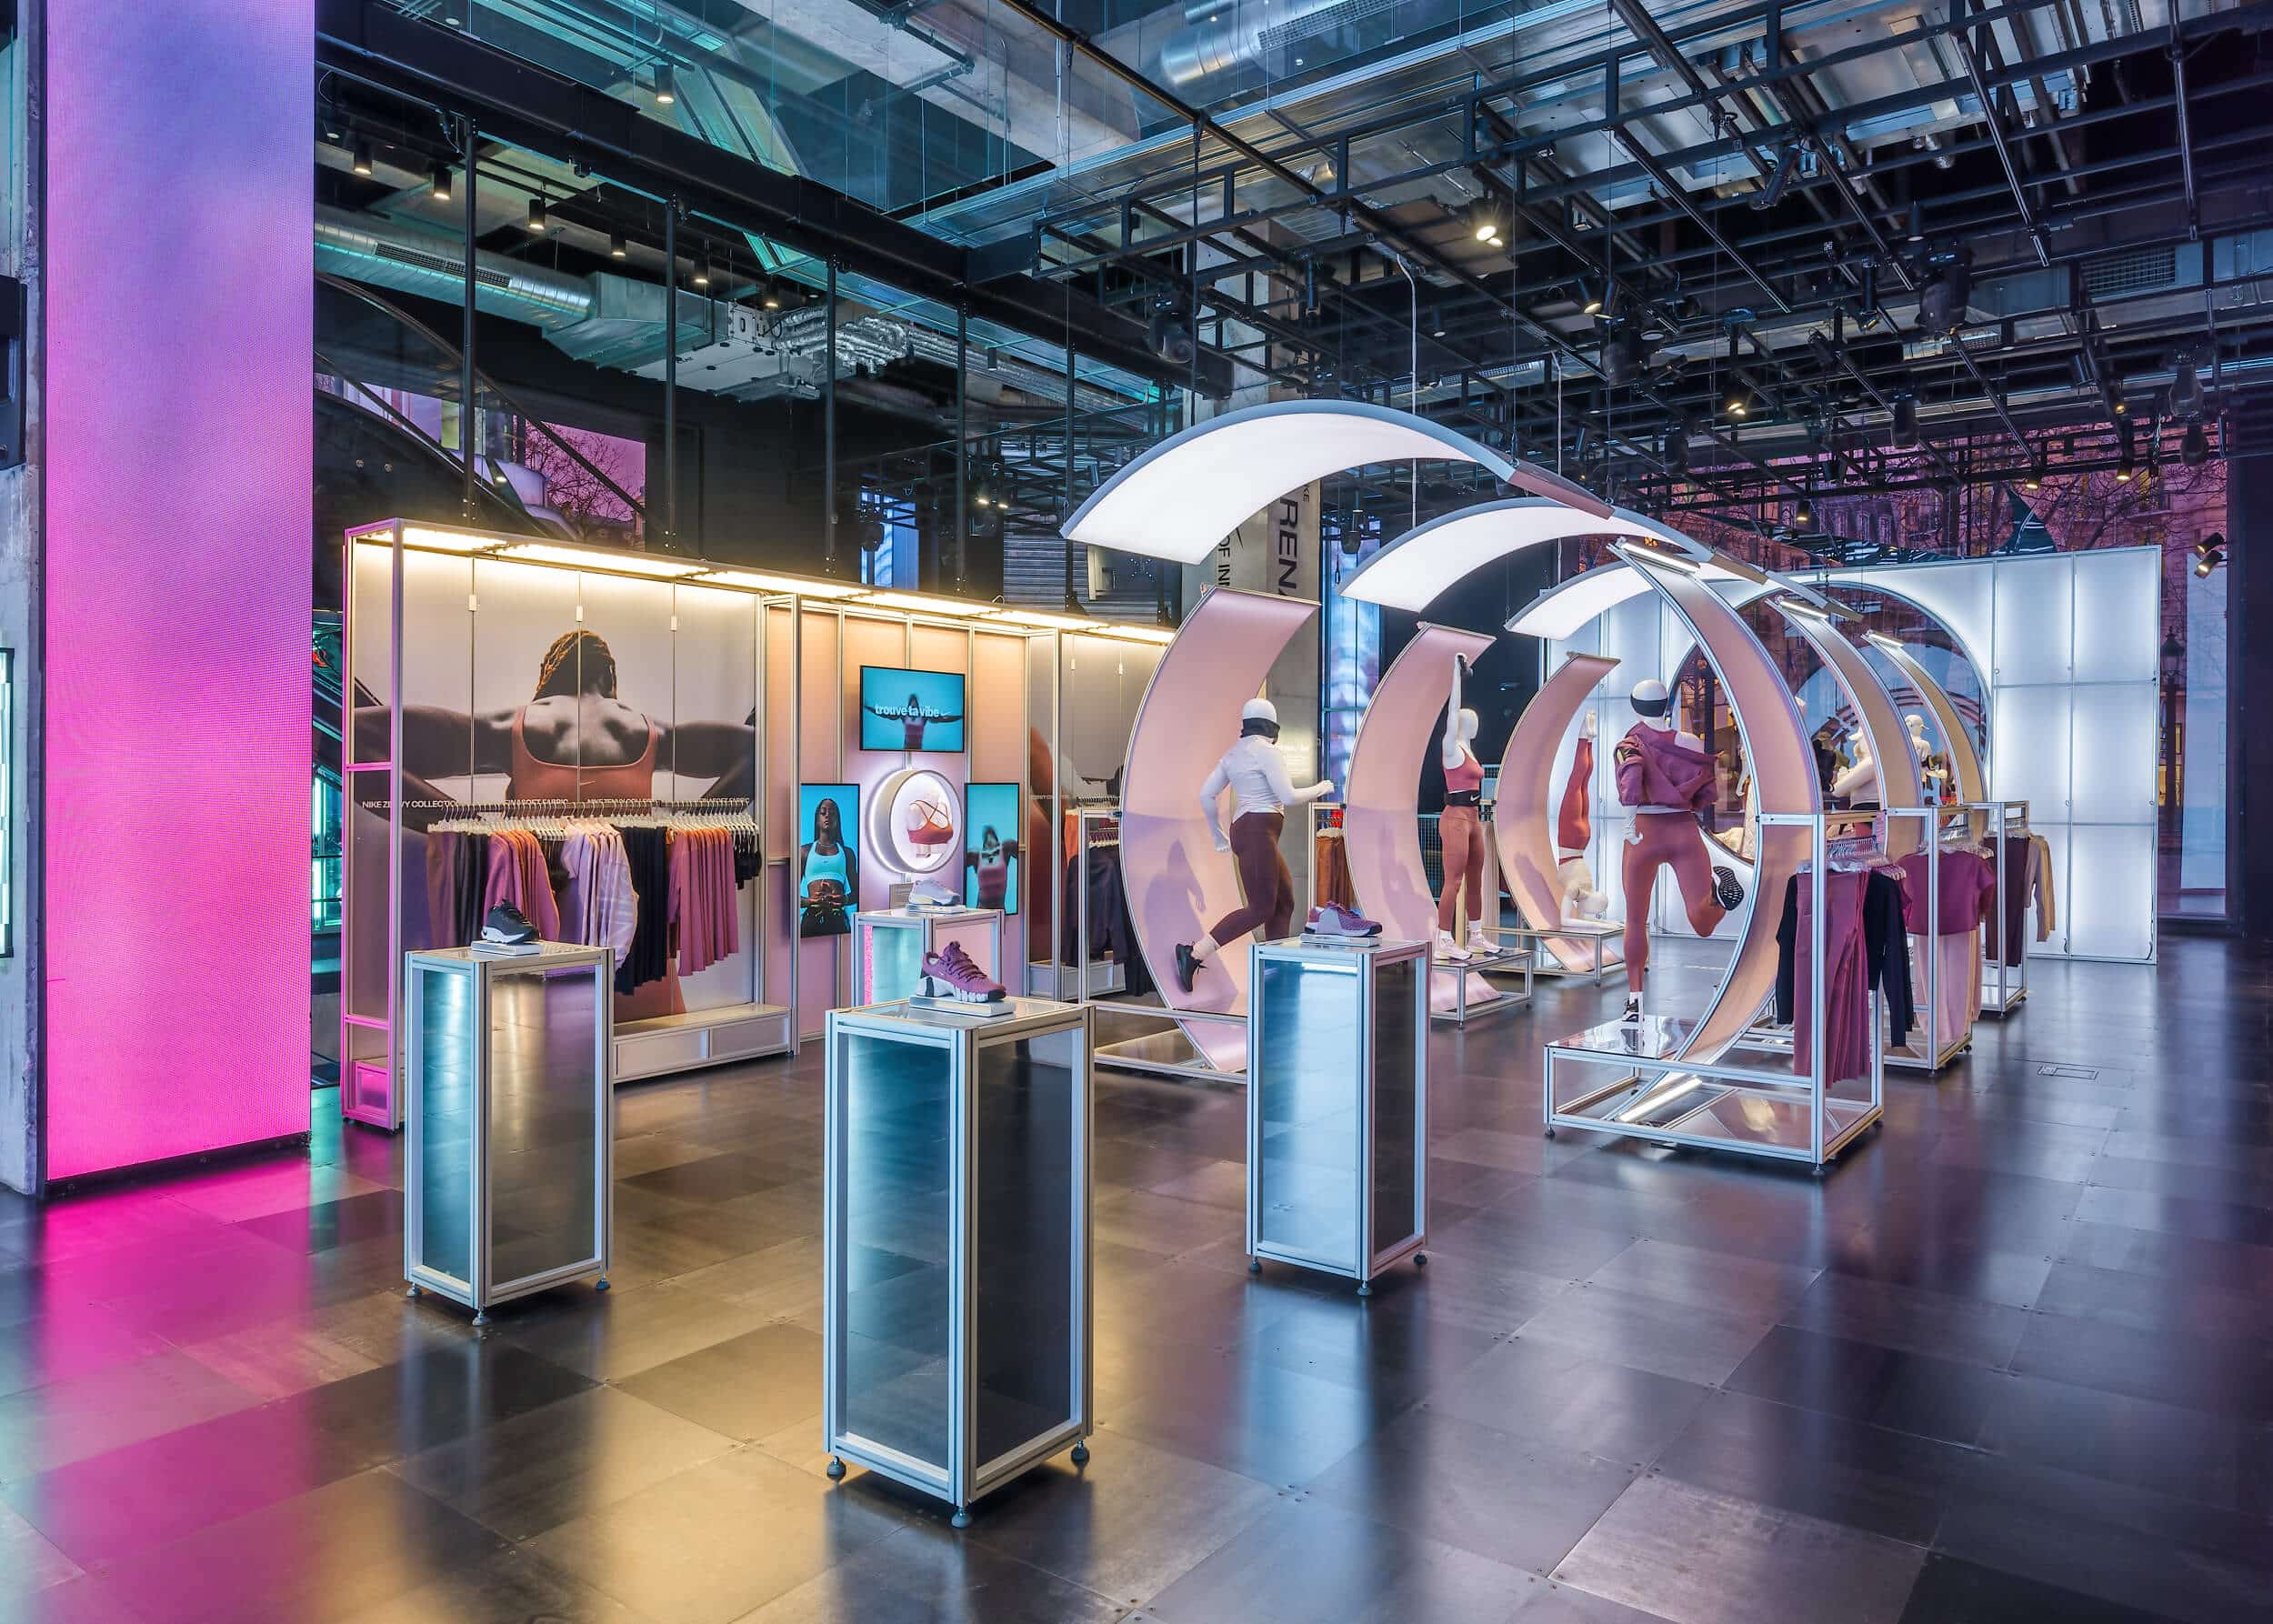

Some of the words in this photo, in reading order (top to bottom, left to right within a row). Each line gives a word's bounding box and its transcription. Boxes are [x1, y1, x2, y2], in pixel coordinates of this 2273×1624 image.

[875, 704, 907, 717] trouve
[907, 706, 919, 717] ta
[919, 706, 940, 717] vibe
[362, 800, 383, 808] NIKE
